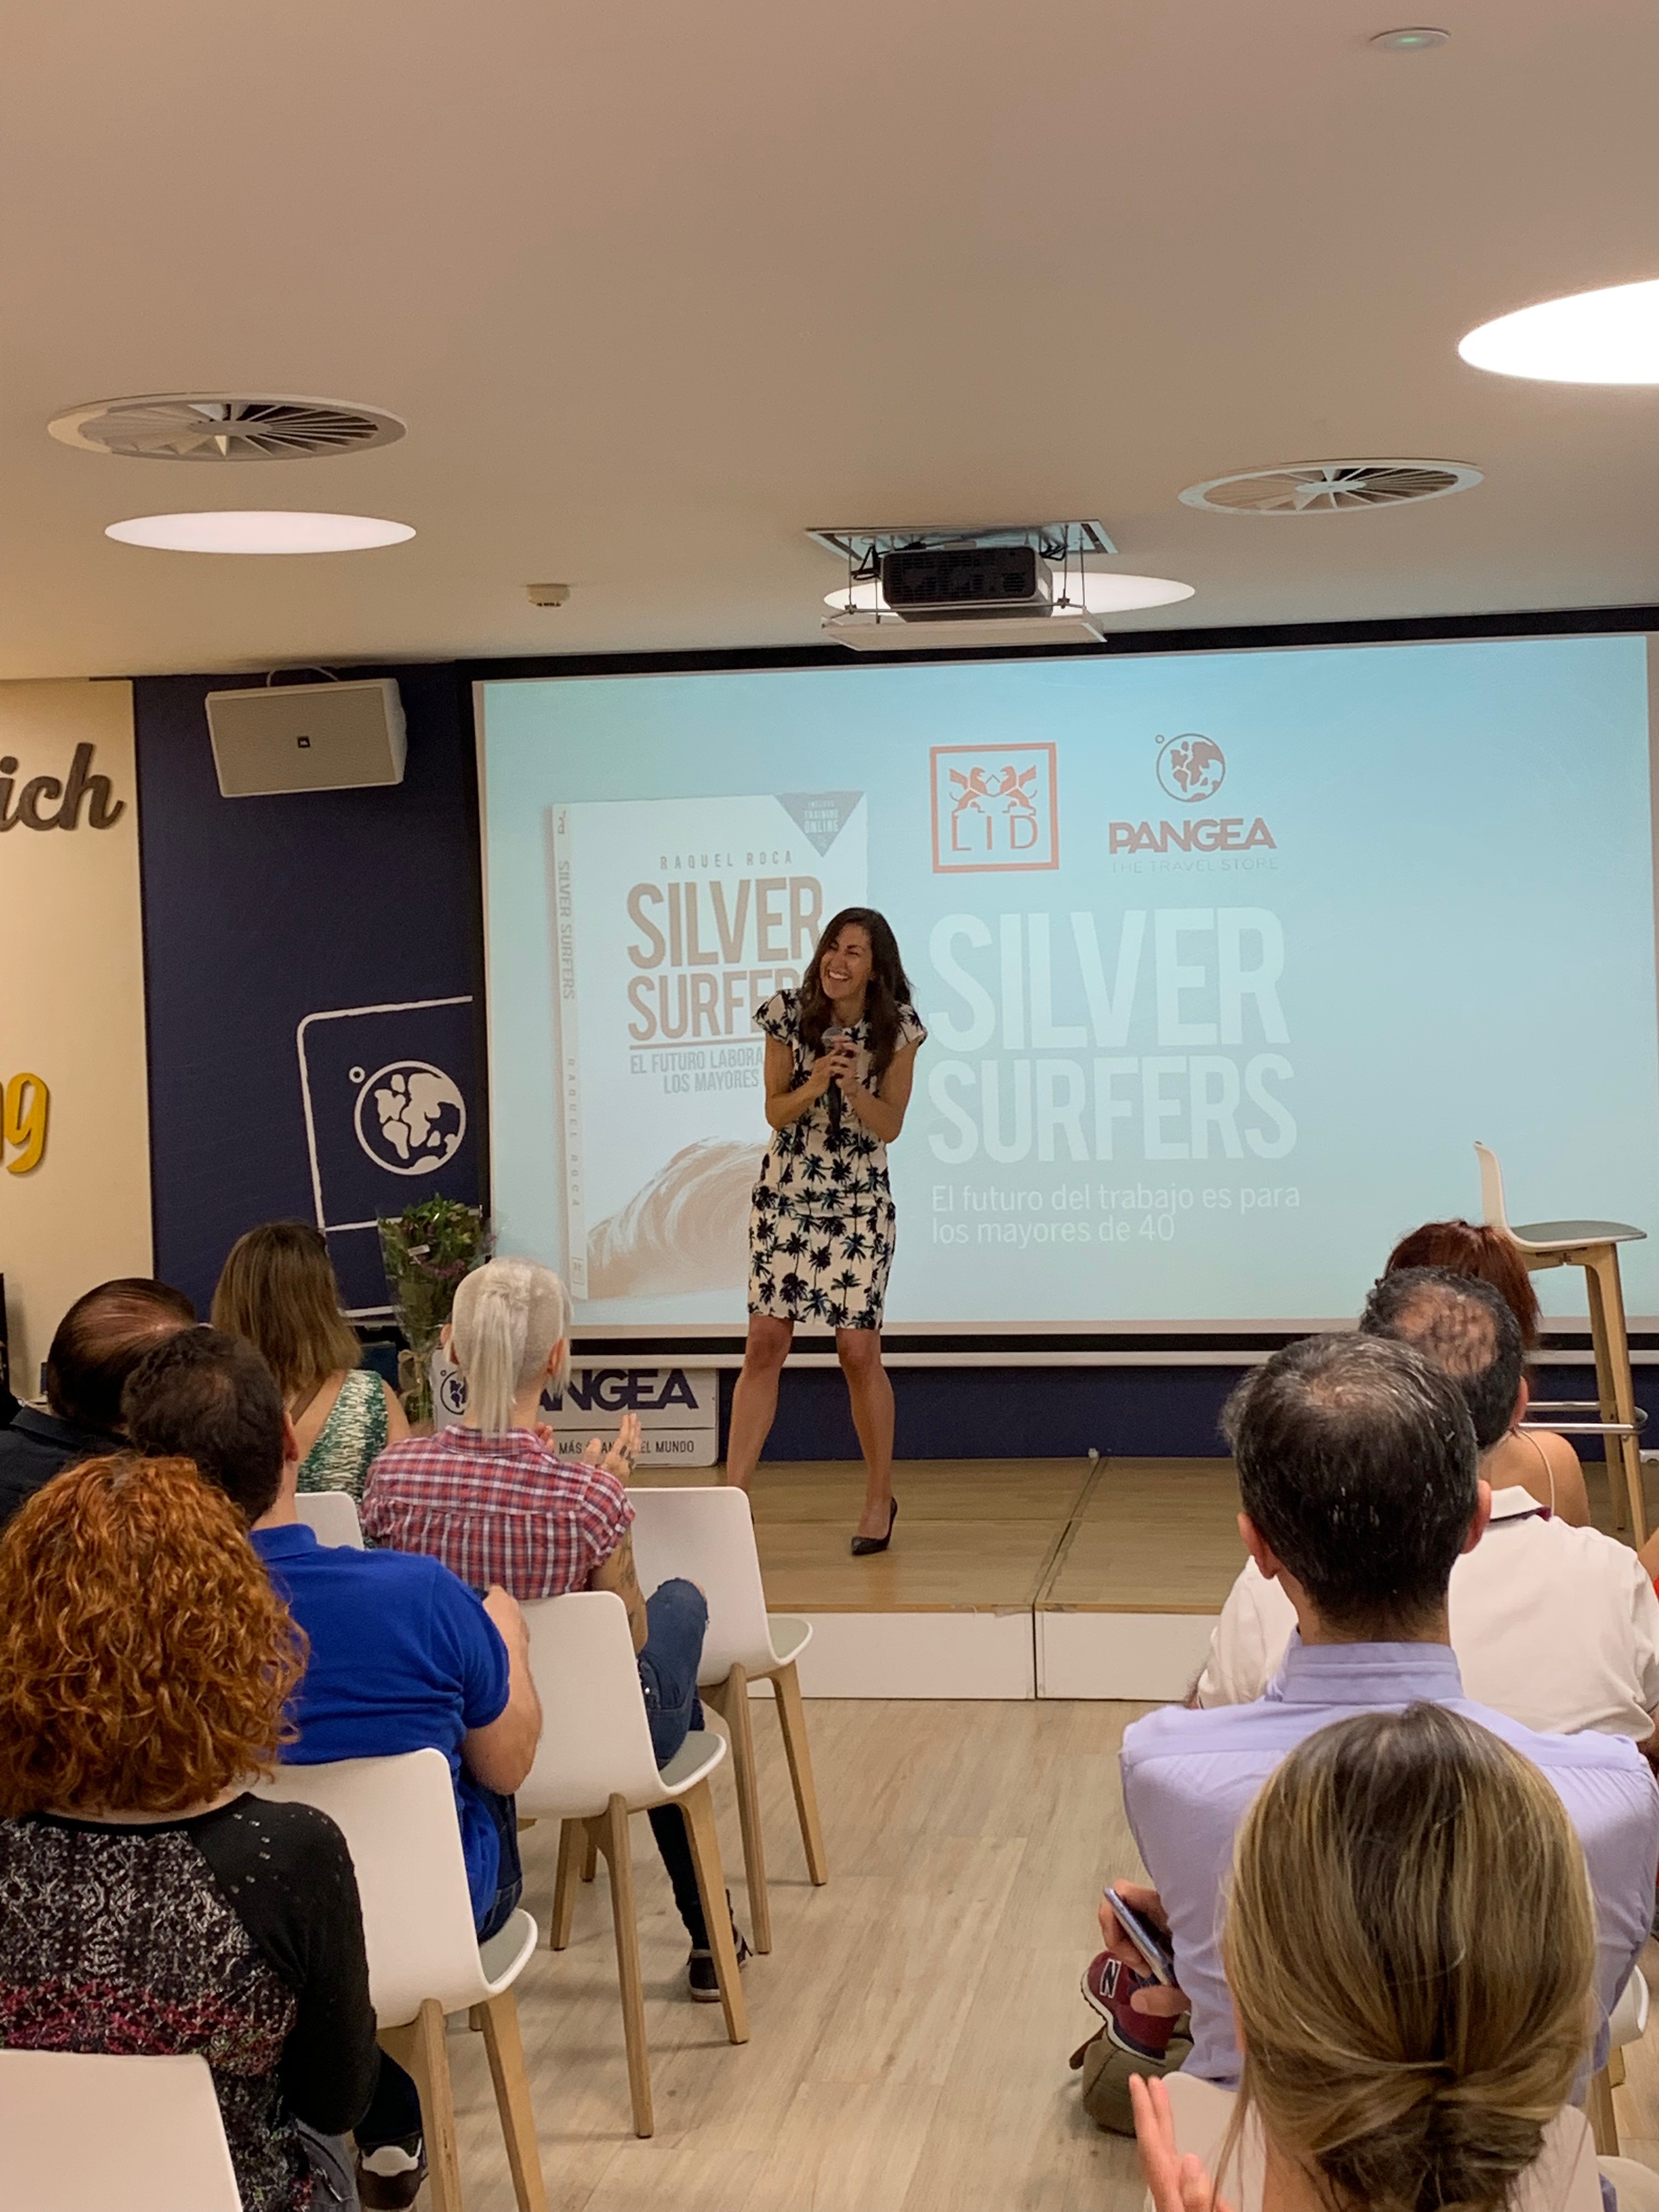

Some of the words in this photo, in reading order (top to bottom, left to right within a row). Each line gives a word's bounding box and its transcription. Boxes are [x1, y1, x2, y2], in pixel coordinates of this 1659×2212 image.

[951, 814, 1039, 851] LID
[1109, 817, 1277, 854] PANGEA
[660, 854, 733, 870] RAQUEL
[747, 850, 792, 866] ROCA
[1112, 861, 1143, 873] THE
[1150, 857, 1216, 873] TRAVEL
[1221, 857, 1278, 871] STORE
[558, 860, 572, 917] SILVER
[627, 876, 824, 969] SILVER
[560, 923, 575, 1000] SURFERS
[927, 906, 1291, 1052] SILVER
[627, 968, 801, 1041] SURFE
[631, 1054, 647, 1075] EL
[651, 1051, 706, 1073] FUTURO
[710, 1046, 765, 1069] LABORA
[663, 1074, 690, 1094] LOS
[695, 1069, 759, 1092] MAYORES
[927, 1053, 1297, 1164] SURFERS
[932, 1185, 955, 1212] El
[963, 1185, 1043, 1211] futuro
[1051, 1184, 1090, 1210] del
[1099, 1183, 1194, 1215] trabajo
[1203, 1188, 1232, 1208] es
[1241, 1187, 1300, 1215] para
[932, 1217, 969, 1244] los
[978, 1222, 1092, 1249] mayores
[1099, 1215, 1131, 1242] de
[1138, 1214, 1175, 1242] 40
[559, 1440, 582, 1454] MÁS
[640, 1441, 651, 1453] EL
[656, 1441, 694, 1453] MUNDO
